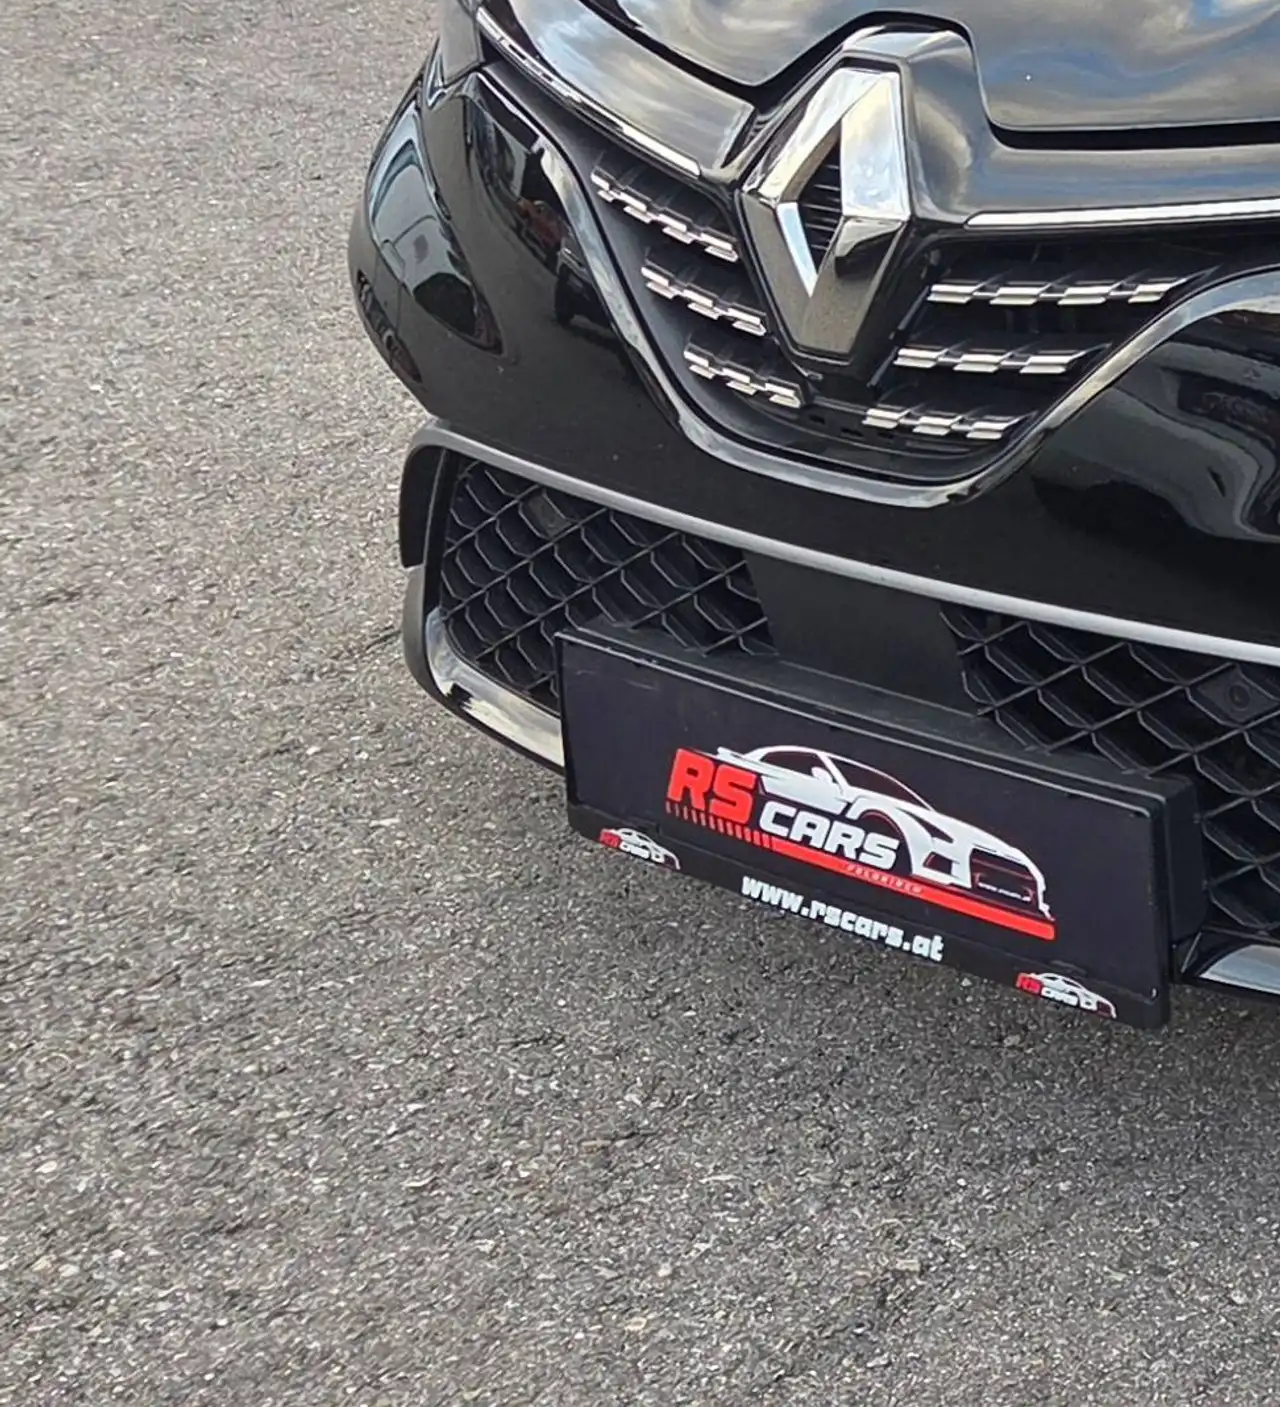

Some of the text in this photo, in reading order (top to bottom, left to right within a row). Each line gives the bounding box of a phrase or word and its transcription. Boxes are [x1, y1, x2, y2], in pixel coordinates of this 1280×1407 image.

[667, 748, 759, 825] RS
[760, 800, 900, 870] CARS
[741, 875, 945, 962] www.rscars.at
